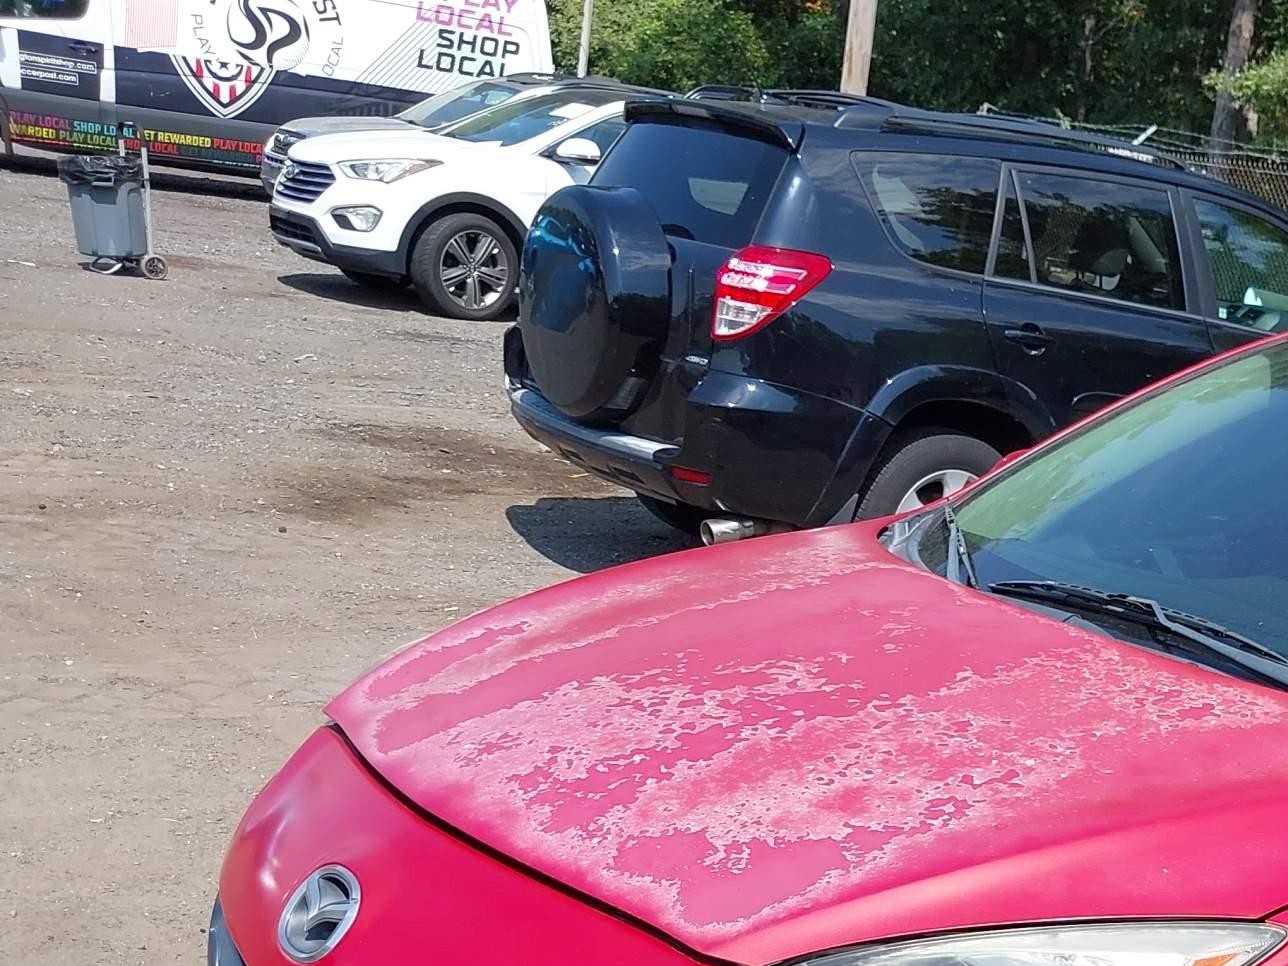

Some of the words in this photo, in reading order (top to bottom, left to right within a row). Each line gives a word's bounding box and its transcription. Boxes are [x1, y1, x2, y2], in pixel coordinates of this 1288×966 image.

[416, 1, 512, 37] LOCAL
[442, 0, 518, 13] AY
[191, 13, 216, 56] PLAY
[437, 28, 520, 59] SHOP
[416, 48, 506, 78] LOCAL
[39, 114, 71, 130] LOCAL
[73, 120, 102, 133] SHOP
[104, 124, 135, 138] LOAL
[157, 131, 211, 148] REWARDED
[213, 138, 239, 152] PLAY
[240, 143, 264, 154] LOCA
[59, 131, 85, 143] PLAY
[87, 134, 118, 147] LOCAL
[150, 141, 179, 154] LOCAL
